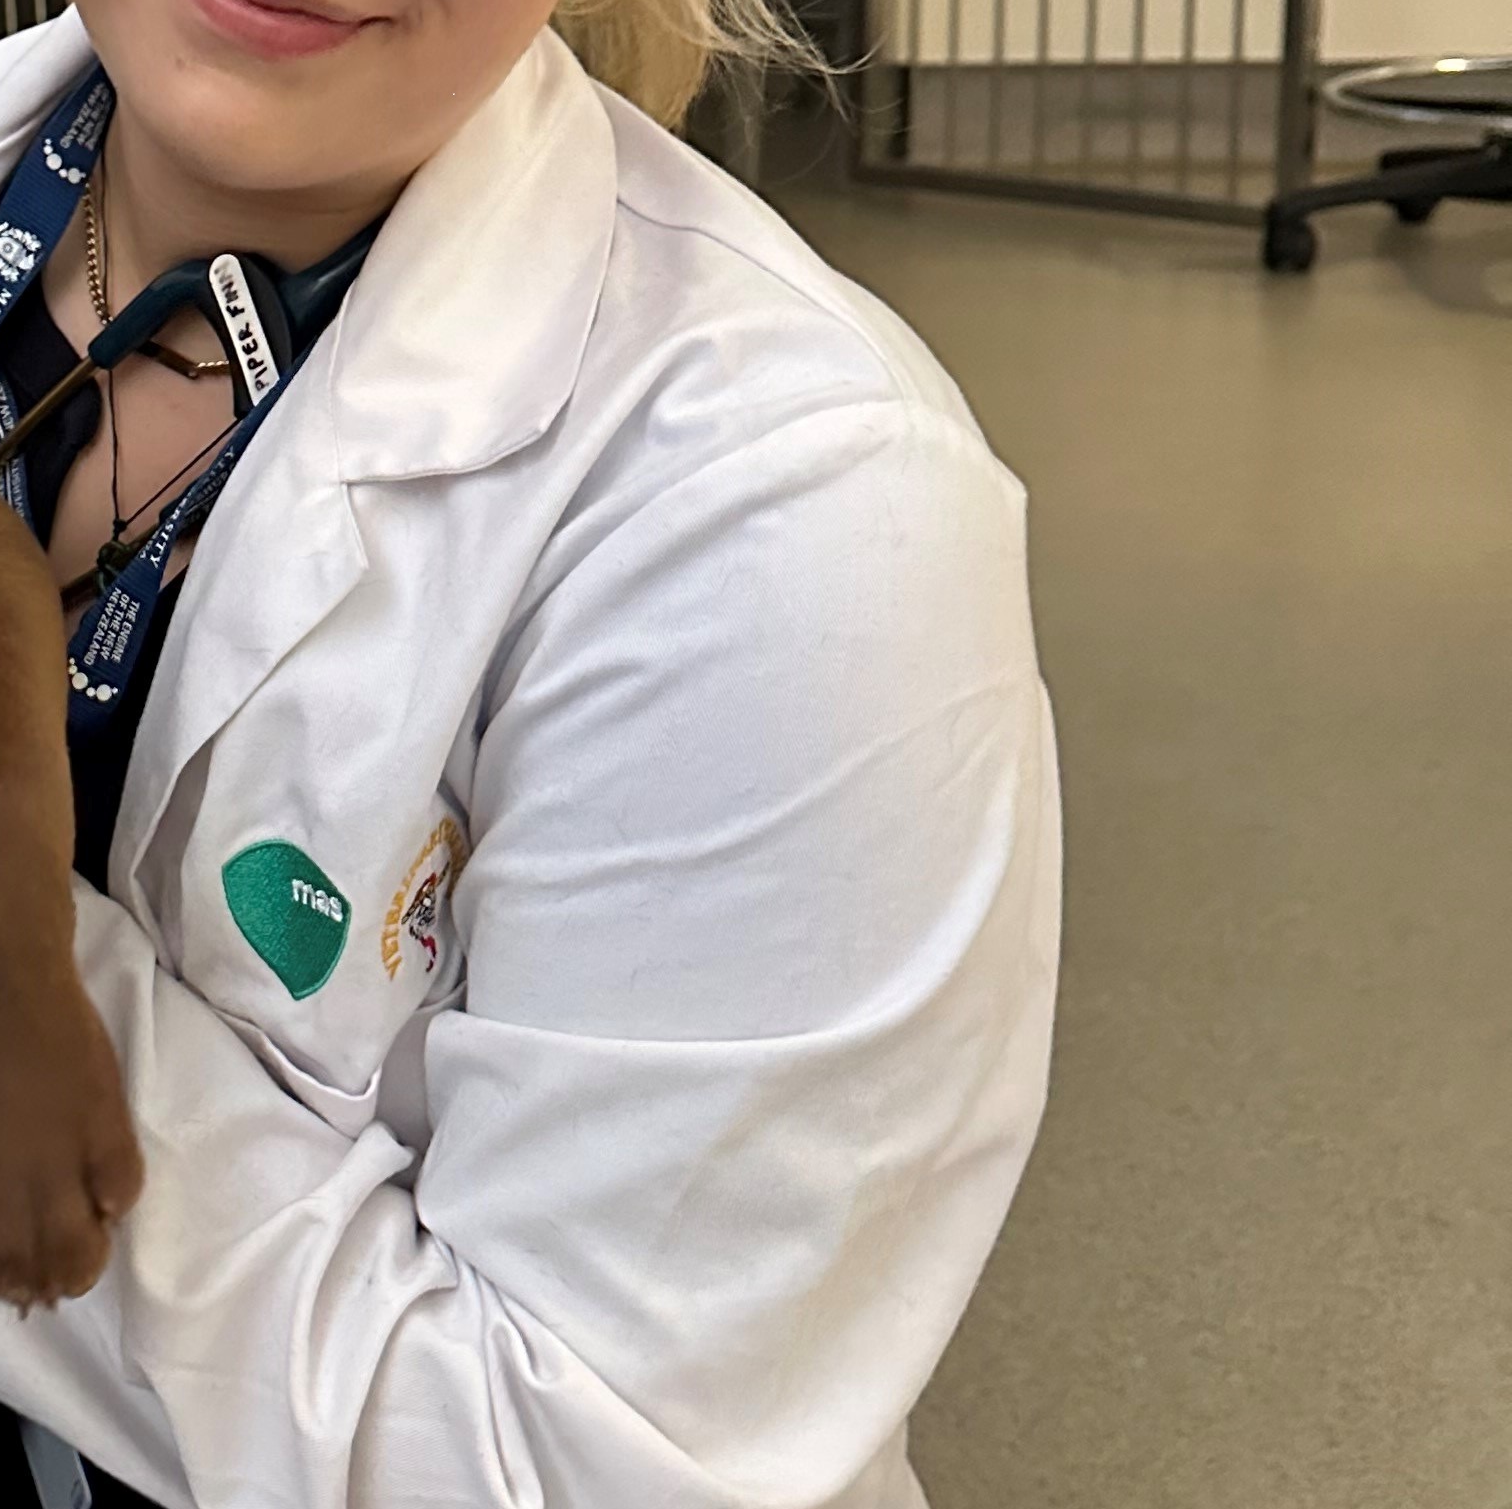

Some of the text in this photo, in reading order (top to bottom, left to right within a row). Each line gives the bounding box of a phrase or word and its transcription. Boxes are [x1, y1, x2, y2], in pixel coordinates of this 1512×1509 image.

[238, 322, 269, 392] PIPER
[83, 587, 122, 666] NEW ZEALAND
[99, 593, 131, 661] OF THE NEW
[110, 600, 141, 664] THE ENGINE
[292, 879, 344, 923] mas
